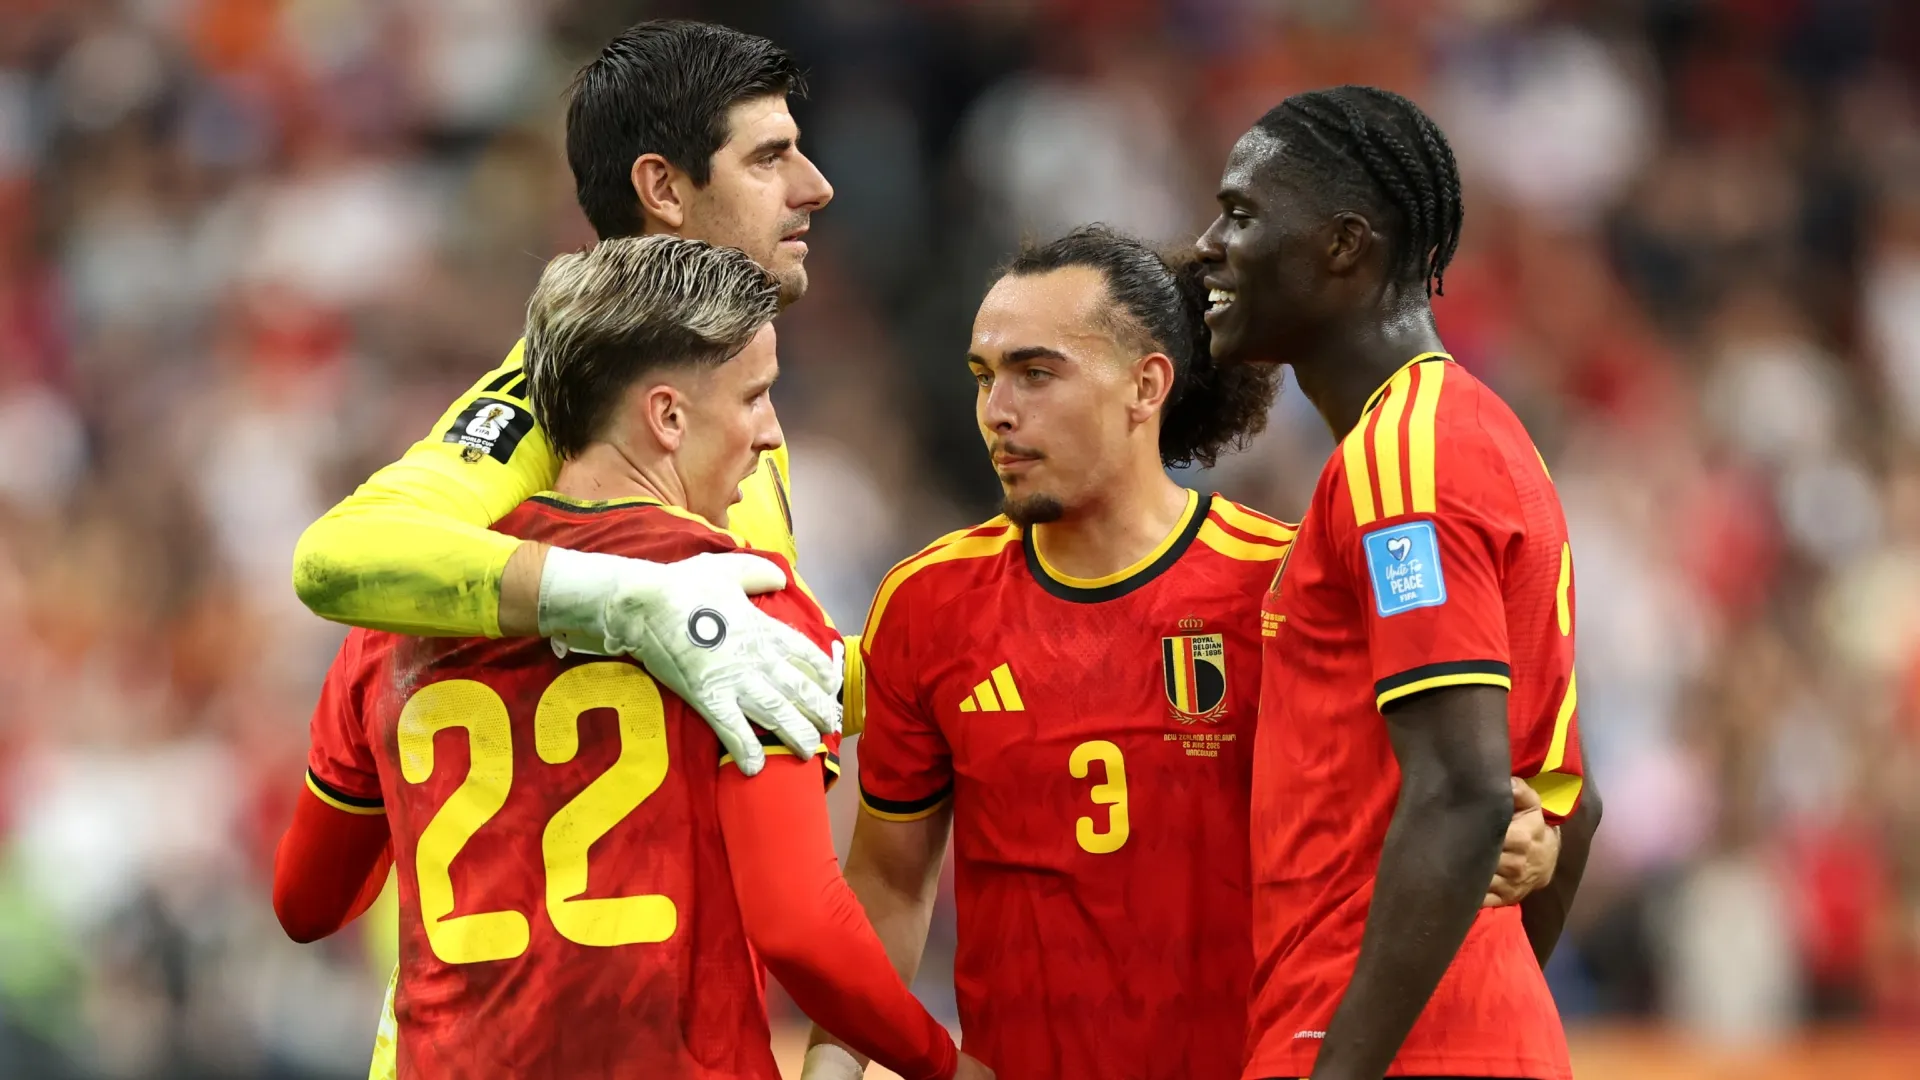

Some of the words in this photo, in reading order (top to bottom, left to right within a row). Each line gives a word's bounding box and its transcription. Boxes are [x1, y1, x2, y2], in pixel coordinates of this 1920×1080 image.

[461, 435, 481, 443] WORLD
[1386, 564, 1408, 580] Unite
[1391, 574, 1424, 594] PEACE
[1400, 592, 1417, 602] FIFA
[1193, 643, 1222, 651] BELGIAN
[1069, 740, 1129, 854] 3
[397, 661, 677, 964] 22
